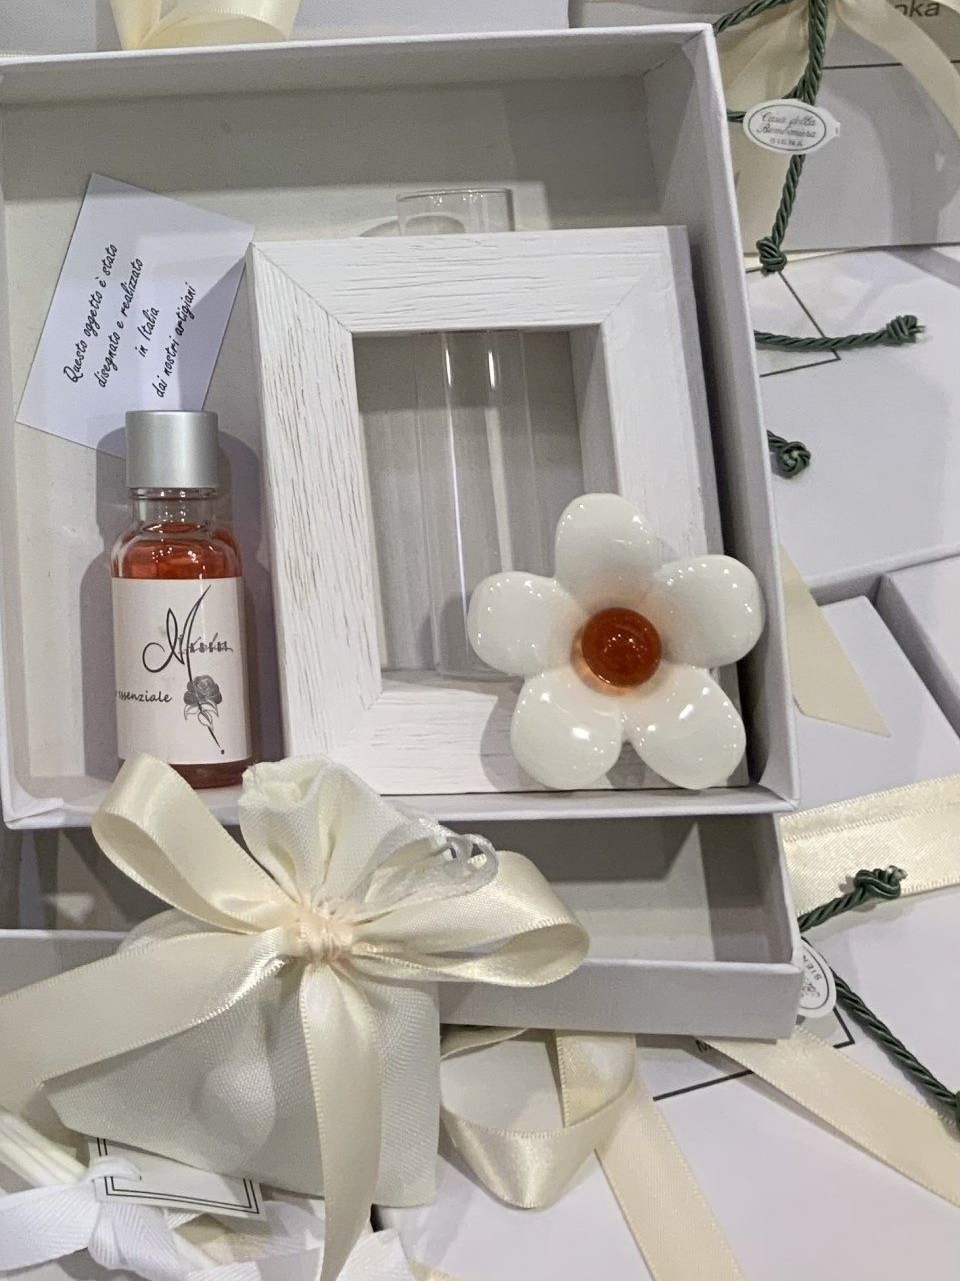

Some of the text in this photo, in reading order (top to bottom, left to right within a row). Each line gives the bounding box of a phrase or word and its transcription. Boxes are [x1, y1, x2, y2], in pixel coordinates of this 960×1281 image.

[63, 244, 118, 383] Questo oggetto è stato
[93, 257, 143, 388] disegnato e realizzato
[134, 307, 160, 358] in Italia
[151, 281, 197, 398] dai nostri artigiani
